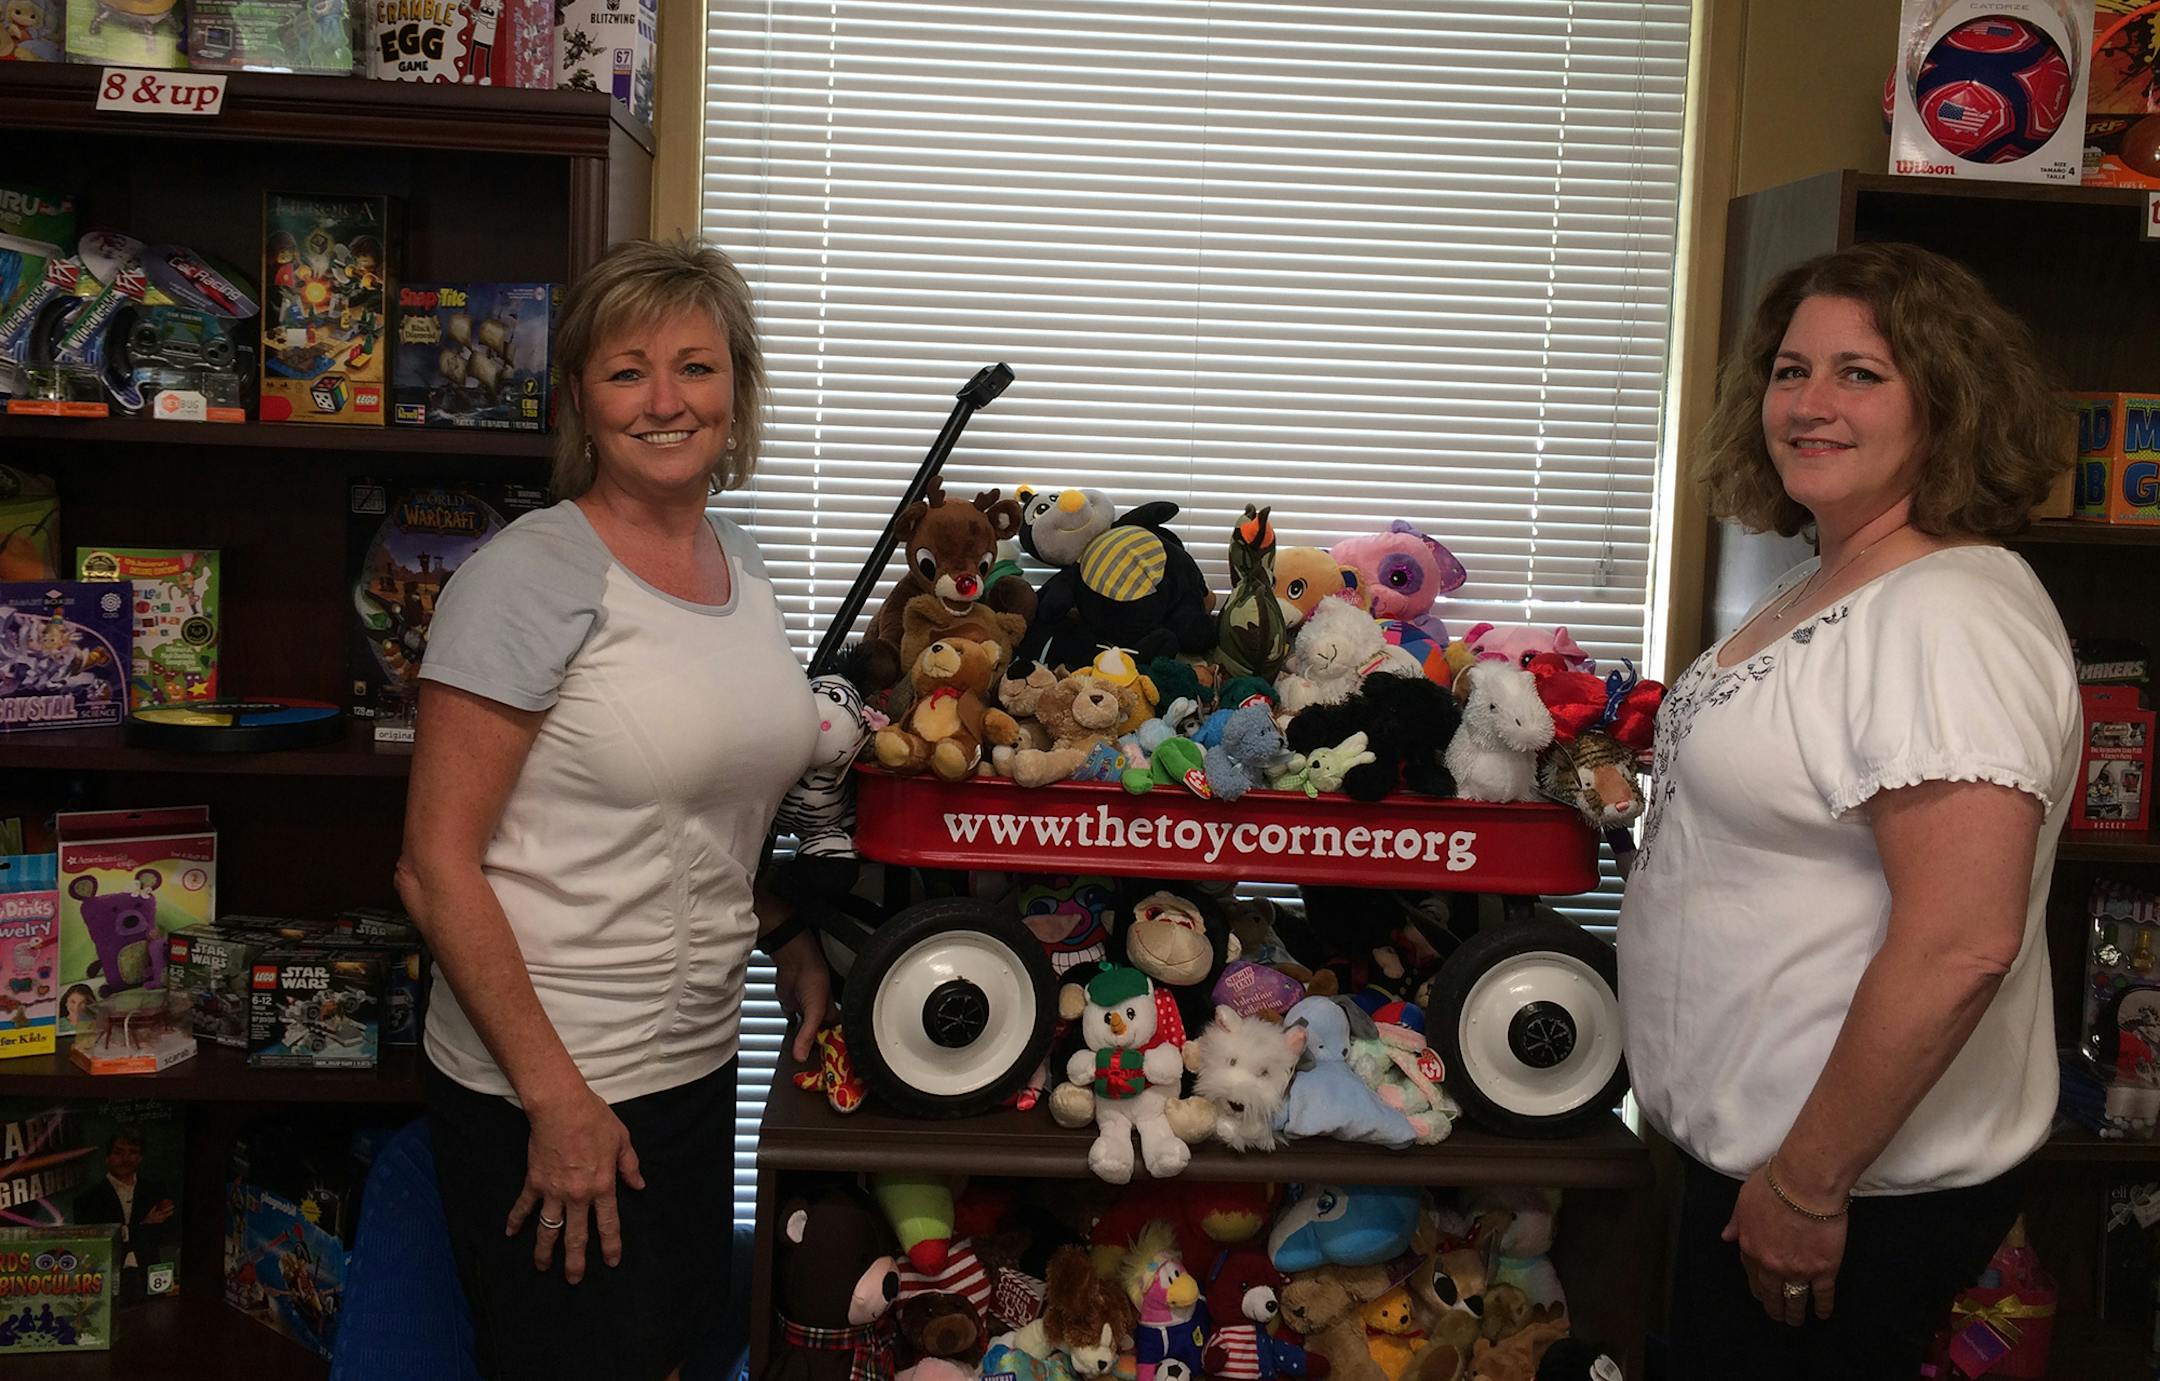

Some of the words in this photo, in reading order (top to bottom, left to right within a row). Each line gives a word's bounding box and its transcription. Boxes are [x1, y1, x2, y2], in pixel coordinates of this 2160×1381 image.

[1969, 3, 2029, 11] CATORZE
[590, 13, 635, 24] BLITZWING
[380, 23, 445, 63] EGG
[616, 51, 630, 63] 67
[398, 60, 429, 72] GAME
[103, 73, 126, 99] 8
[132, 75, 165, 104] &
[170, 85, 219, 111] up
[1895, 160, 1955, 175] Wilson
[2068, 167, 2075, 176] 4
[169, 256, 198, 279] Car
[193, 269, 240, 300] Racing
[24, 283, 51, 311] GAME
[399, 287, 439, 311] Snap
[439, 287, 468, 308] Tite
[69, 309, 100, 348] VIDEO
[97, 291, 122, 318] GAME
[416, 494, 465, 506] WORLD
[404, 503, 477, 529] WARCRAFT
[80, 708, 117, 718] SCIENCE
[943, 805, 1477, 872] www.thetoycorner.org
[5, 900, 55, 918] Dinks
[191, 942, 228, 958] STAR
[191, 954, 228, 969] WARS
[254, 972, 274, 982] LEGO
[281, 966, 330, 978] STAR
[281, 977, 330, 990] WARS
[251, 996, 273, 1005] 6-12
[1233, 990, 1273, 1007] Valentine
[1237, 999, 1284, 1017] Collection
[153, 1278, 168, 1289] 8+
